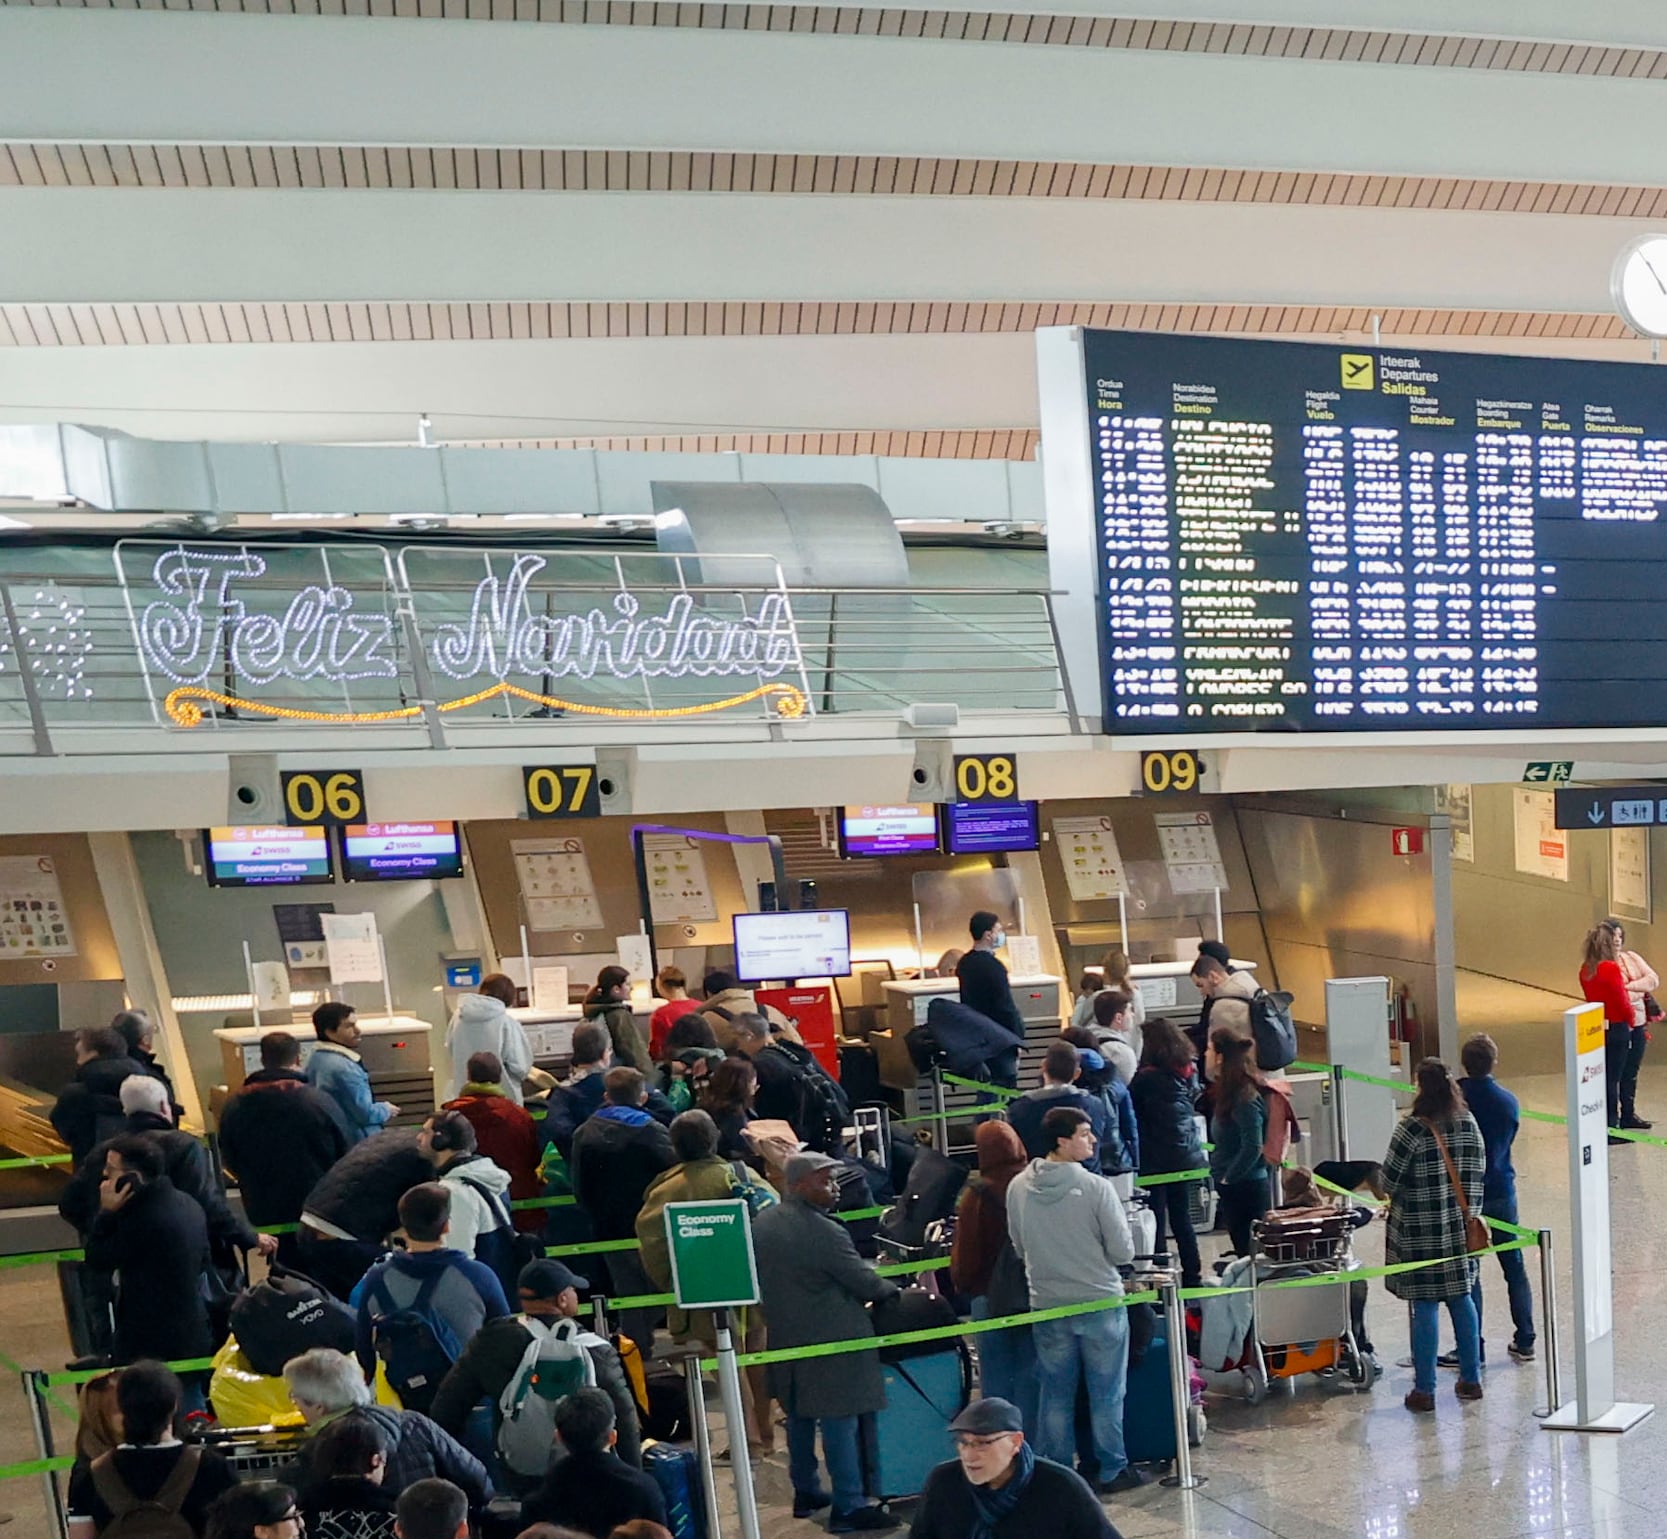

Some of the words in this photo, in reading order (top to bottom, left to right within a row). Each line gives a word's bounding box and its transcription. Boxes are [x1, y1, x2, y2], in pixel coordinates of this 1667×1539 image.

[1380, 355, 1421, 368] Irteerak
[1380, 367, 1439, 383] Departures
[1098, 389, 1119, 398] Time
[1381, 382, 1426, 396] Salidas
[1098, 399, 1123, 410] Hora
[1173, 393, 1218, 404] Destination
[1174, 403, 1211, 415] Destino
[1307, 410, 1335, 420] Vuelo
[1410, 415, 1455, 426] Mostrador
[1477, 417, 1522, 429] Embarque
[1542, 420, 1571, 431] Puerta
[1585, 422, 1644, 434] Observaciones
[141, 549, 398, 686] Feliz
[432, 553, 791, 680] Navidad
[958, 757, 1014, 798] 08
[1144, 752, 1196, 792] 09
[527, 768, 594, 813] 07
[287, 773, 361, 821] 06
[236, 864, 280, 875] Economy
[281, 862, 307, 873] Class
[370, 858, 411, 869] Economy
[412, 857, 437, 867] Class
[677, 1214, 736, 1226] Economy
[678, 1226, 714, 1238] Class
